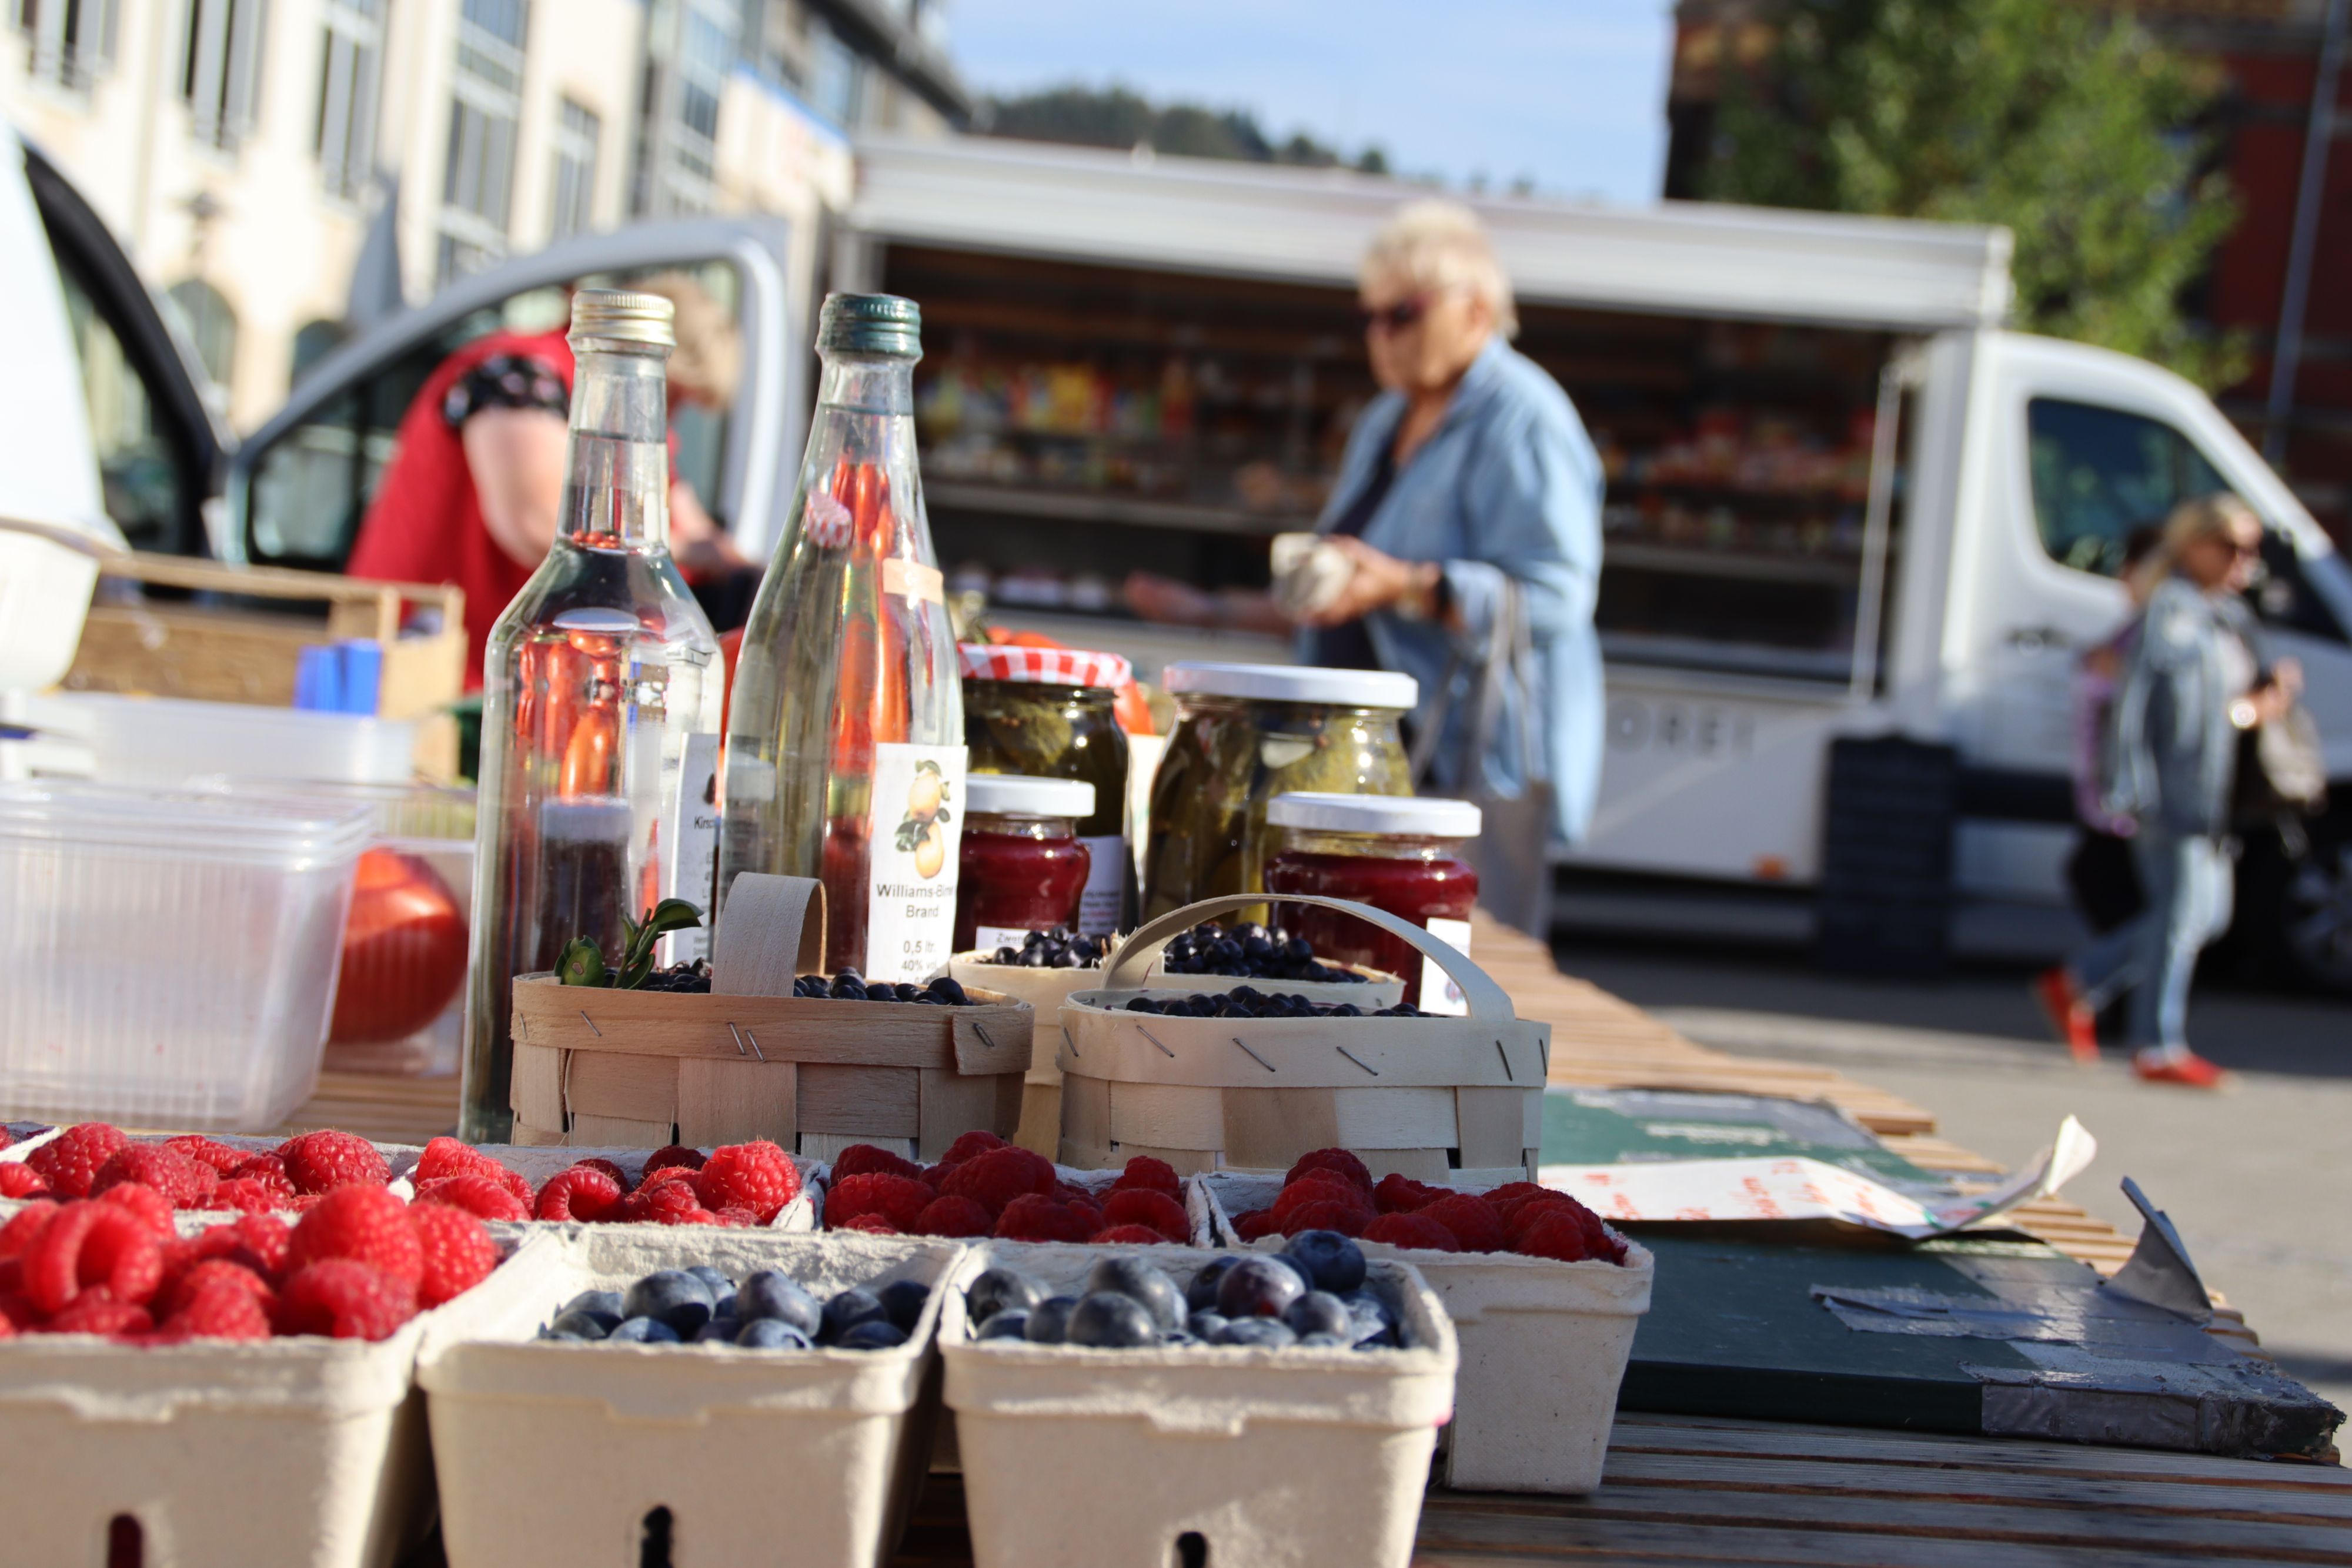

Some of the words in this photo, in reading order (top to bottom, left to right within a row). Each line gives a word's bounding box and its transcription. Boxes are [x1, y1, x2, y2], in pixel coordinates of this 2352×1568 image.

[694, 815, 716, 830] Kirsc
[906, 904, 939, 918] Brand
[903, 940, 923, 955] 0,5
[901, 959, 923, 972] 40%
